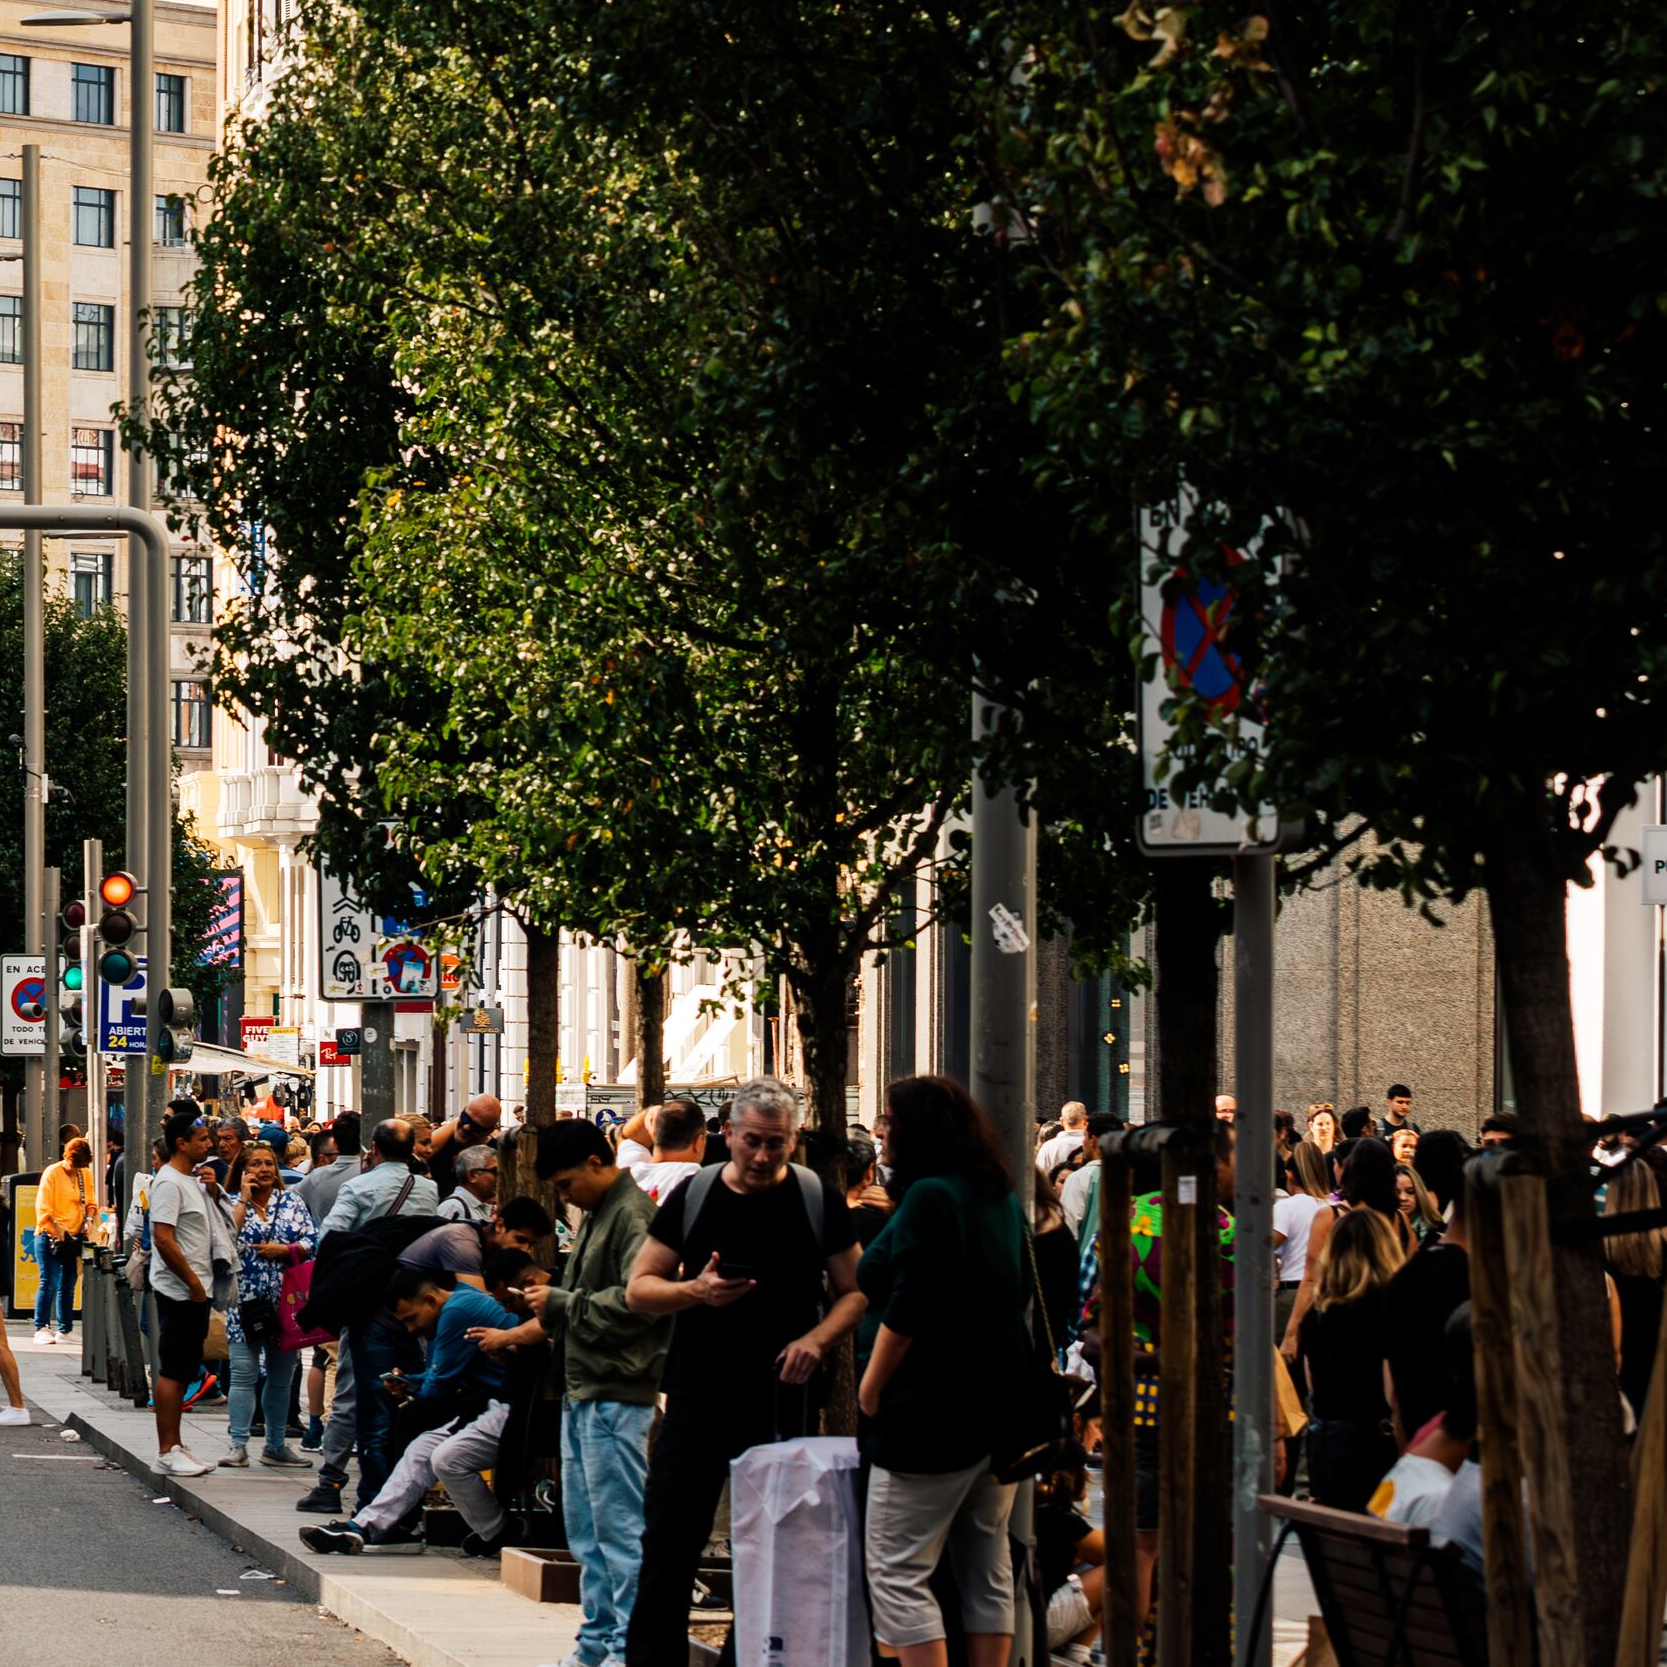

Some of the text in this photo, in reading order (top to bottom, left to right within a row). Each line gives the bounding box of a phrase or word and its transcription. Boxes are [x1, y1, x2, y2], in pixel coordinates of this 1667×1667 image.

[6, 965, 46, 974] EN ACE
[108, 1026, 147, 1036] ABIERT
[245, 1025, 269, 1034] FIVE
[108, 1035, 128, 1048] 24
